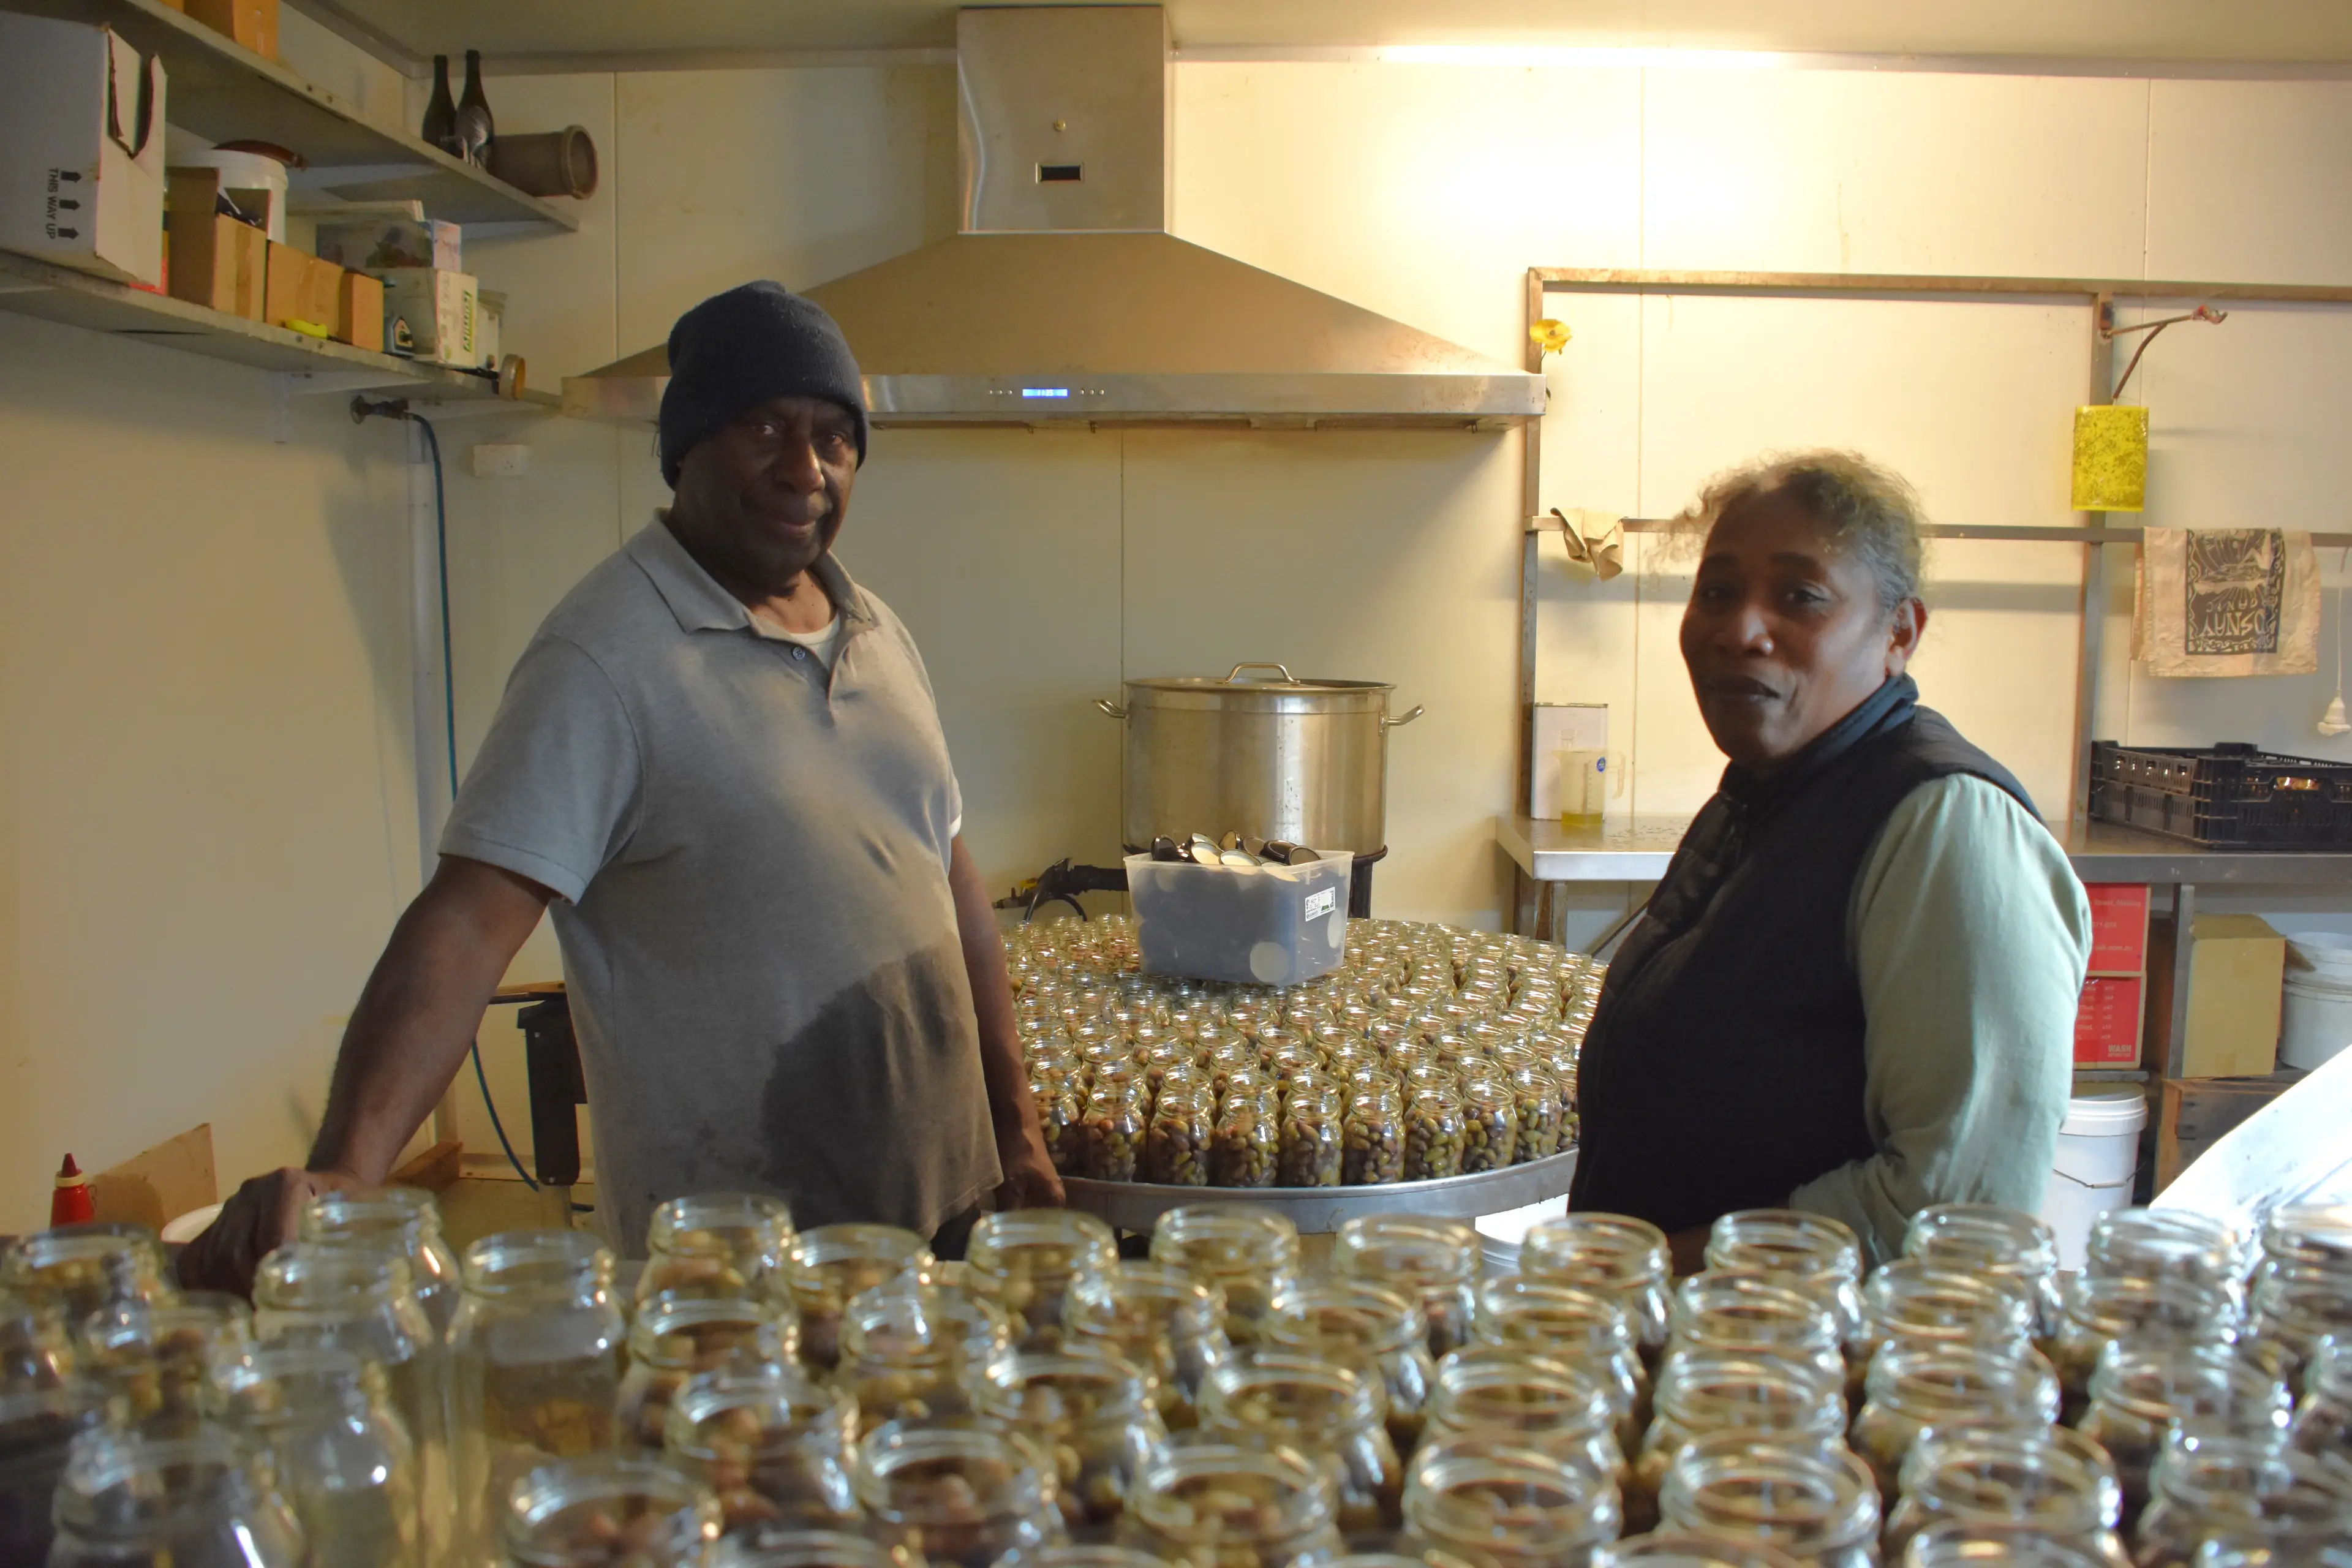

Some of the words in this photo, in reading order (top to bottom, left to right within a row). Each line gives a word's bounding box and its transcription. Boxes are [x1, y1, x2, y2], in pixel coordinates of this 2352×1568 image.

[48, 168, 59, 192] THIS
[47, 196, 57, 220] WAY
[46, 223, 56, 239] UP
